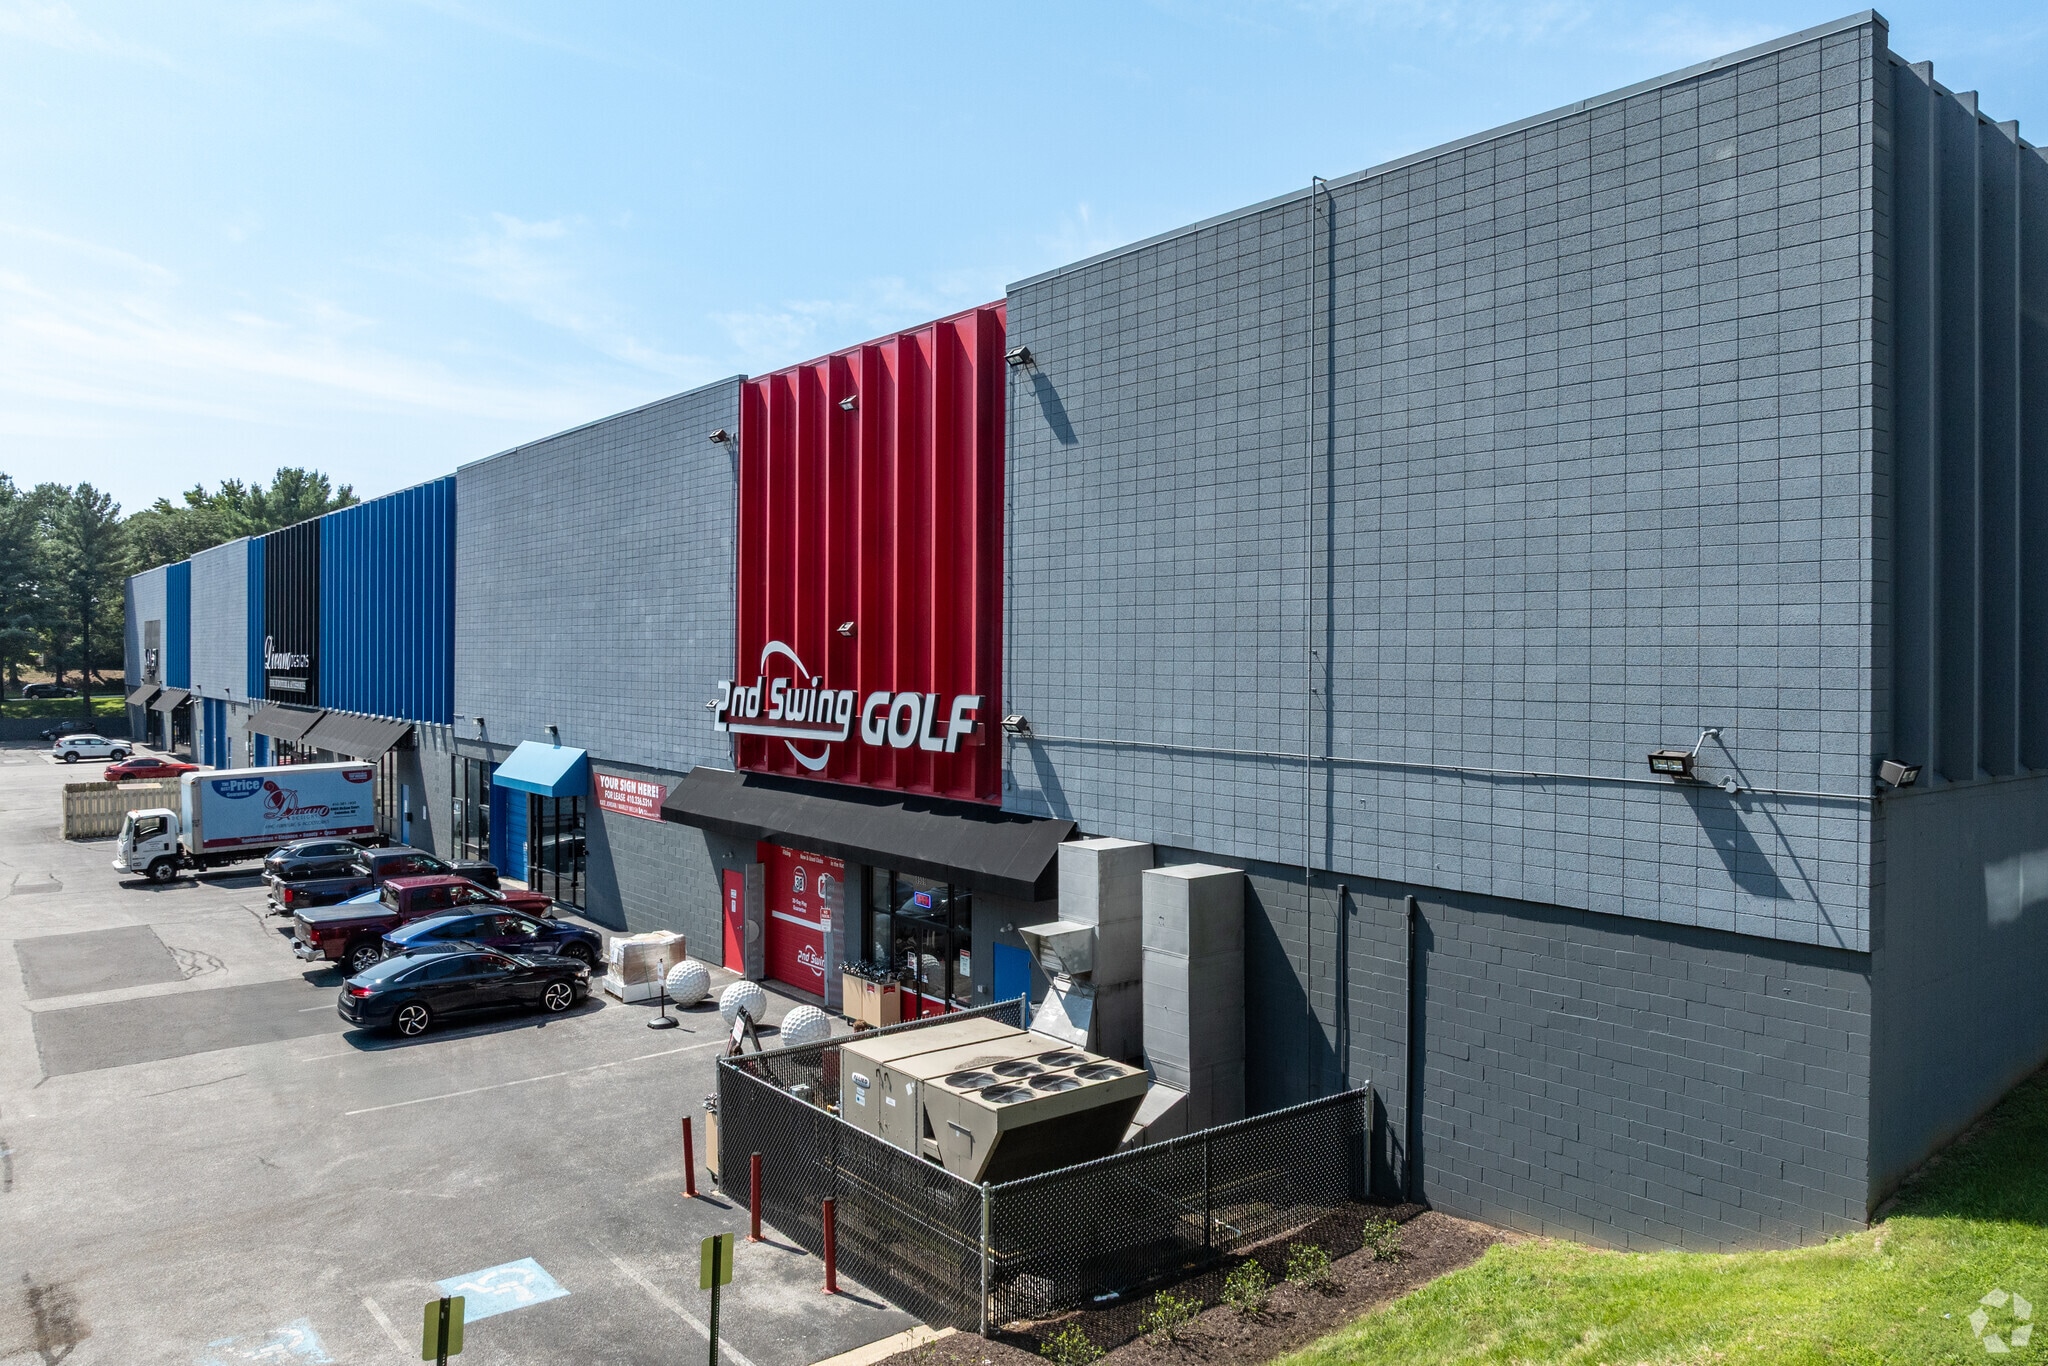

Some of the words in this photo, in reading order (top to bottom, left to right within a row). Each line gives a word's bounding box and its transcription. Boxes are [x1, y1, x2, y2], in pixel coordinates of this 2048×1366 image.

[714, 676, 767, 732] 2nd
[769, 676, 858, 741] Swing
[861, 691, 986, 753] GOLF
[230, 780, 260, 791] Price
[600, 776, 618, 790] YOUR
[620, 779, 636, 793] SIGN
[638, 783, 659, 798] HERE!
[264, 788, 329, 820] Divano
[605, 790, 614, 799] FOR
[614, 792, 625, 802] LEASE
[797, 950, 809, 963] 2nd
